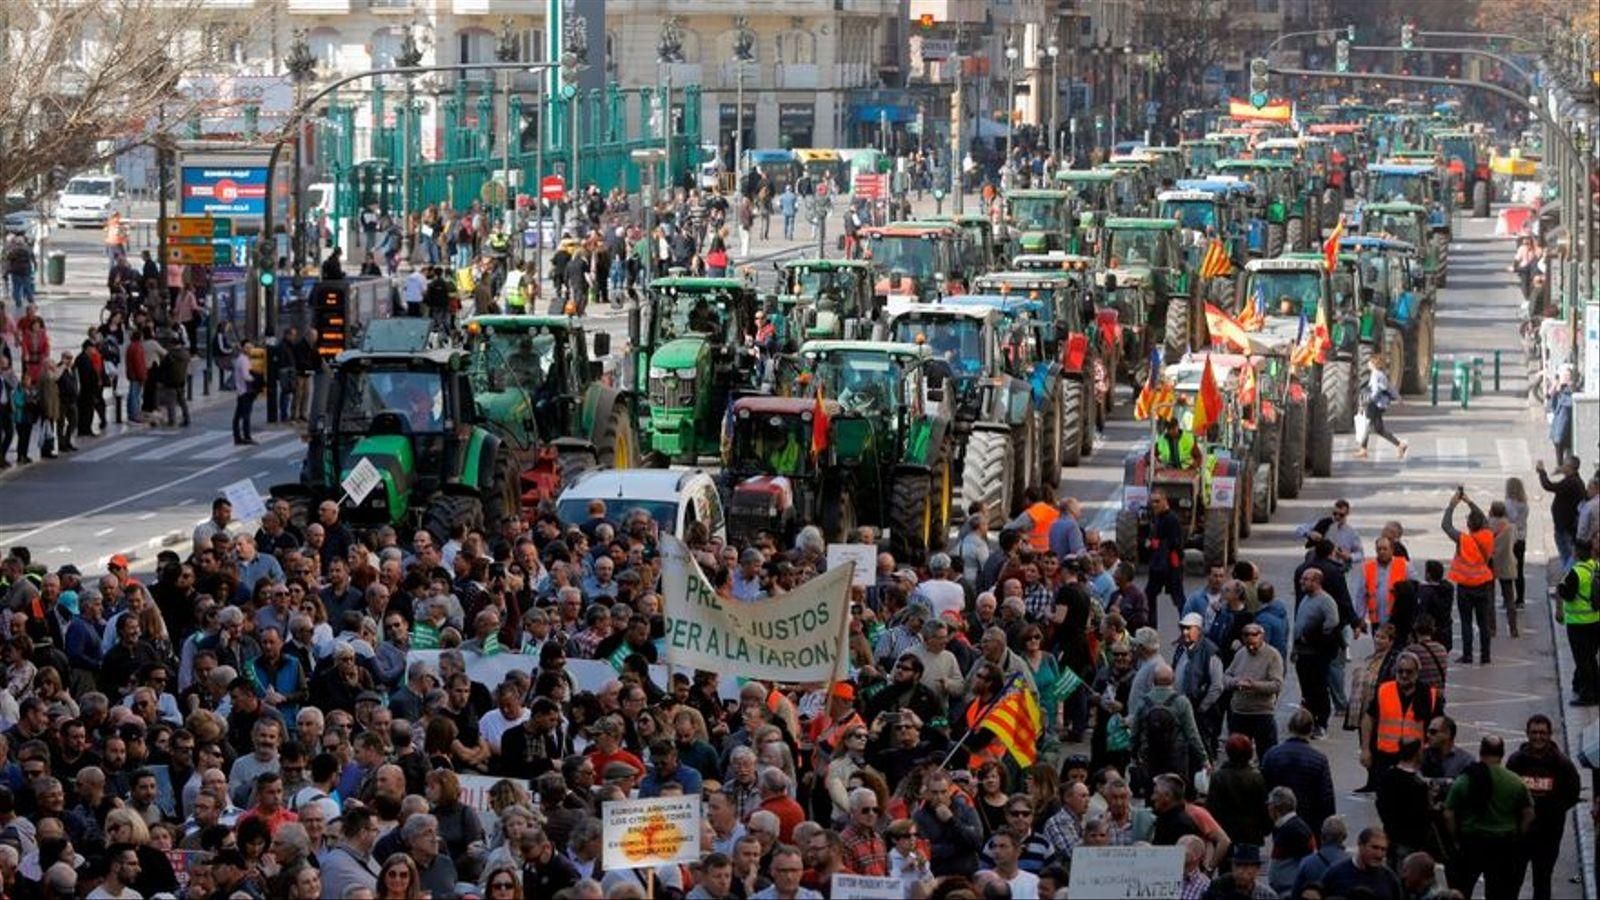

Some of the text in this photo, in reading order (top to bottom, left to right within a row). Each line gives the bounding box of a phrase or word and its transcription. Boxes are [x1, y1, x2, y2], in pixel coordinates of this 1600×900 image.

[665, 617, 702, 651] PER
[706, 627, 720, 656] A
[725, 633, 750, 663] LA
